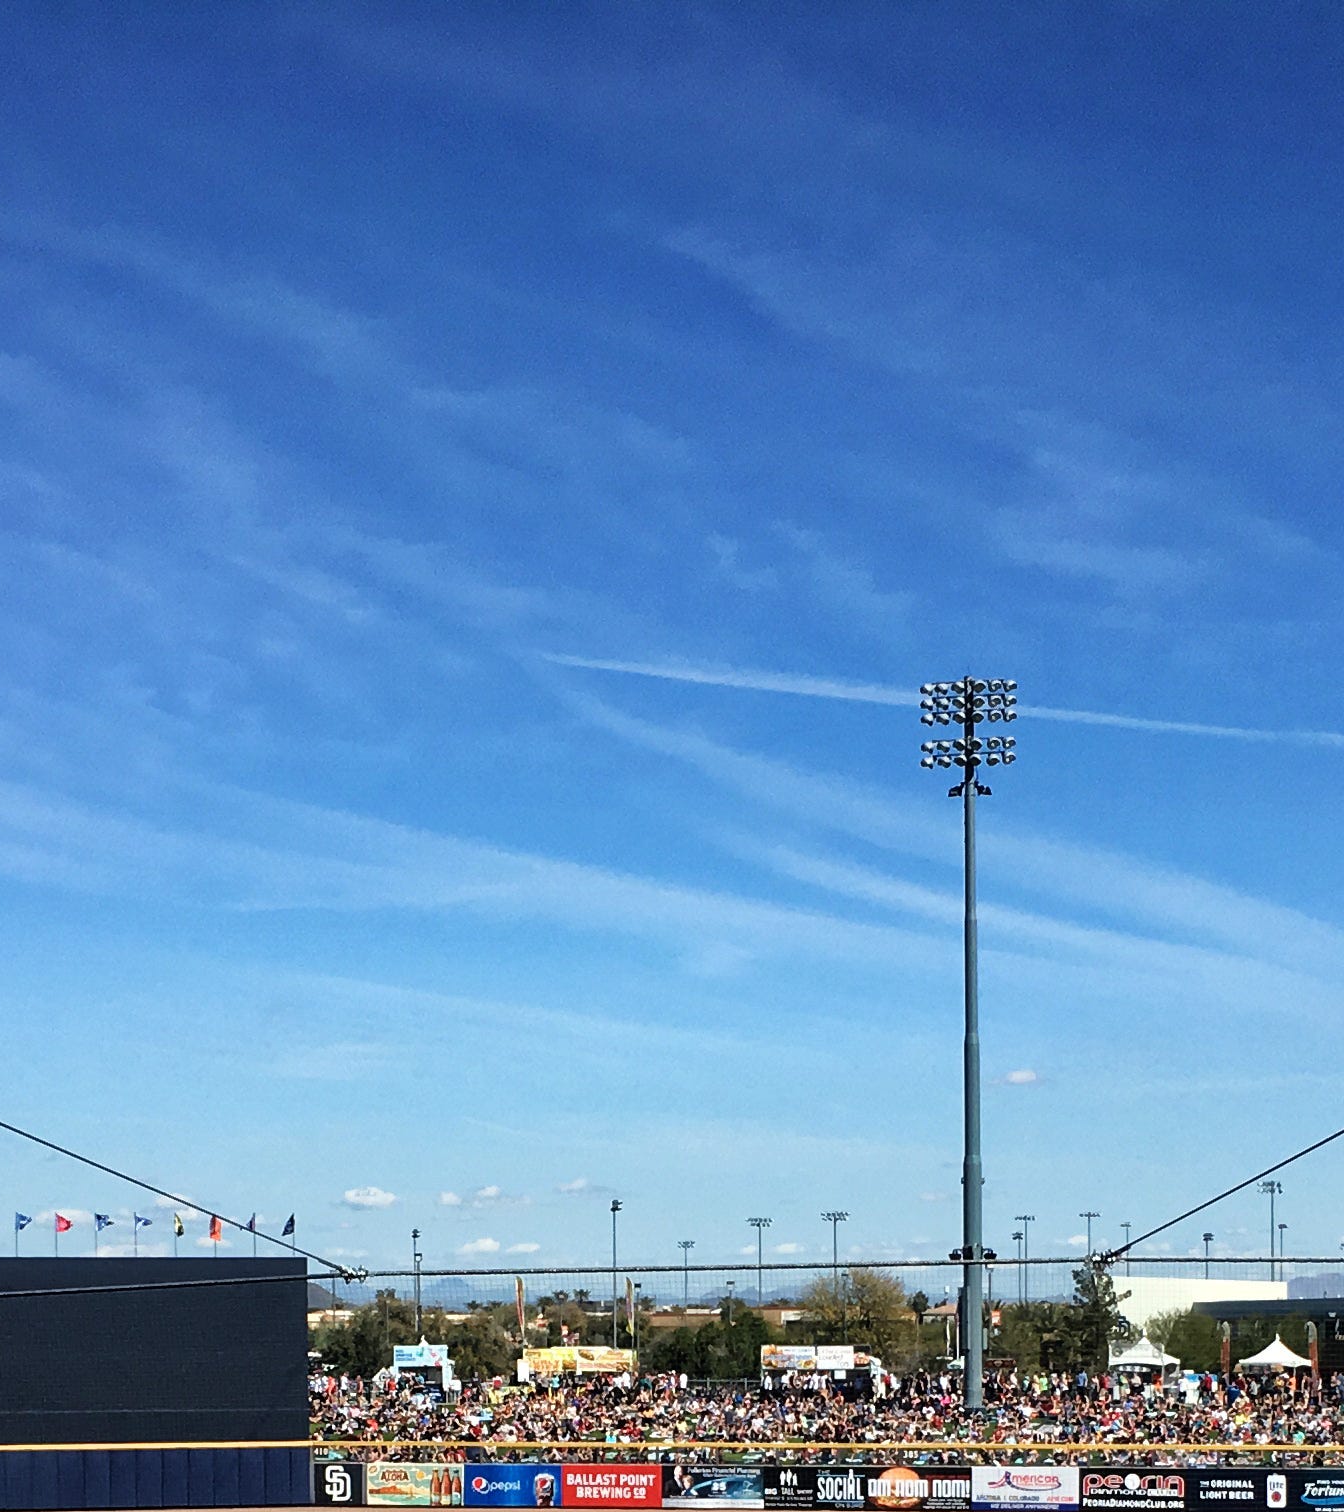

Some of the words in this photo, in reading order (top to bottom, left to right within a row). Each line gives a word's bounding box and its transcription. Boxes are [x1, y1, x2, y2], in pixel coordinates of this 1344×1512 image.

[490, 1479, 521, 1493] pepsi
[566, 1473, 617, 1486] BALLAST
[619, 1474, 657, 1487] POINT
[817, 1469, 865, 1501] SOCIAL
[1210, 1479, 1254, 1489] ORIGINAL
[576, 1487, 632, 1499] BREWING
[1199, 1490, 1228, 1500] LIGHT
[1228, 1491, 1254, 1500] BEER
